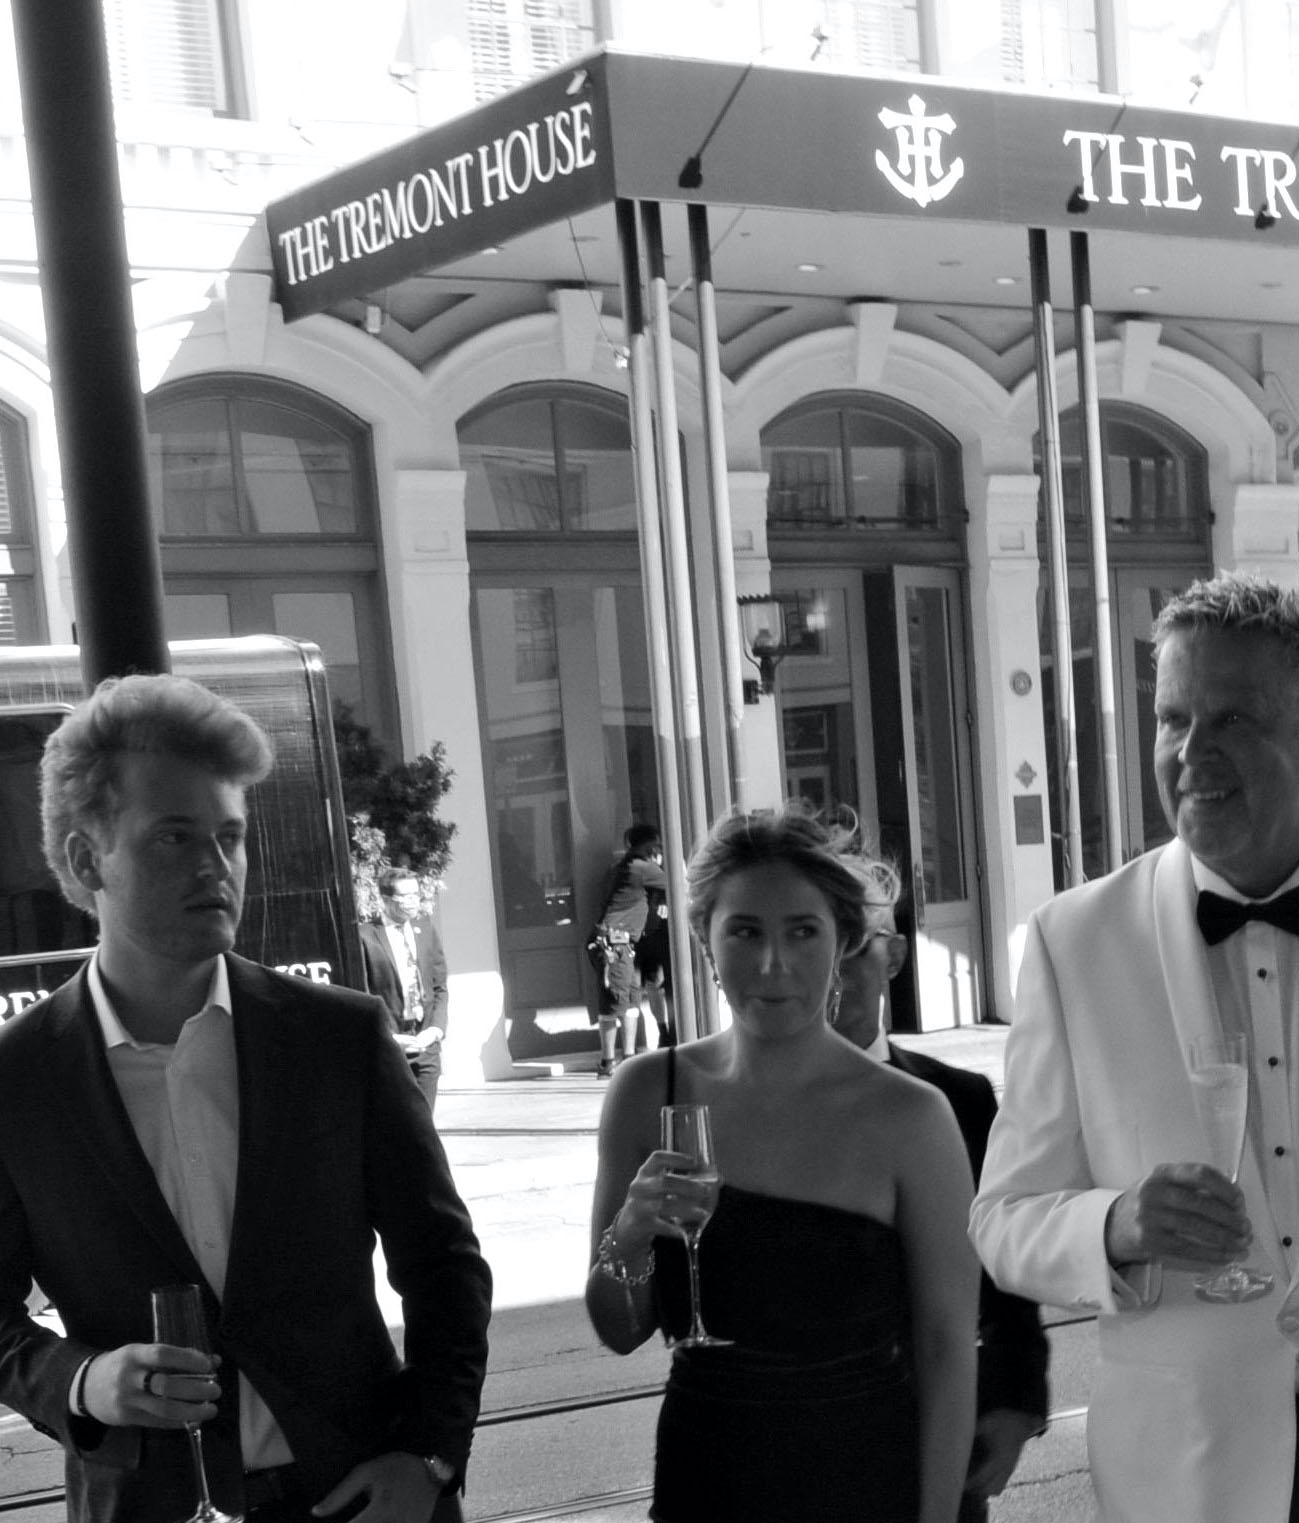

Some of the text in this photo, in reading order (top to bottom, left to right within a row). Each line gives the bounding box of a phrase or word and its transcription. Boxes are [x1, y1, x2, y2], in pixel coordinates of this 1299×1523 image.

[279, 101, 597, 285] THE TREMONT HOUSE
[1062, 129, 1203, 211] THE
